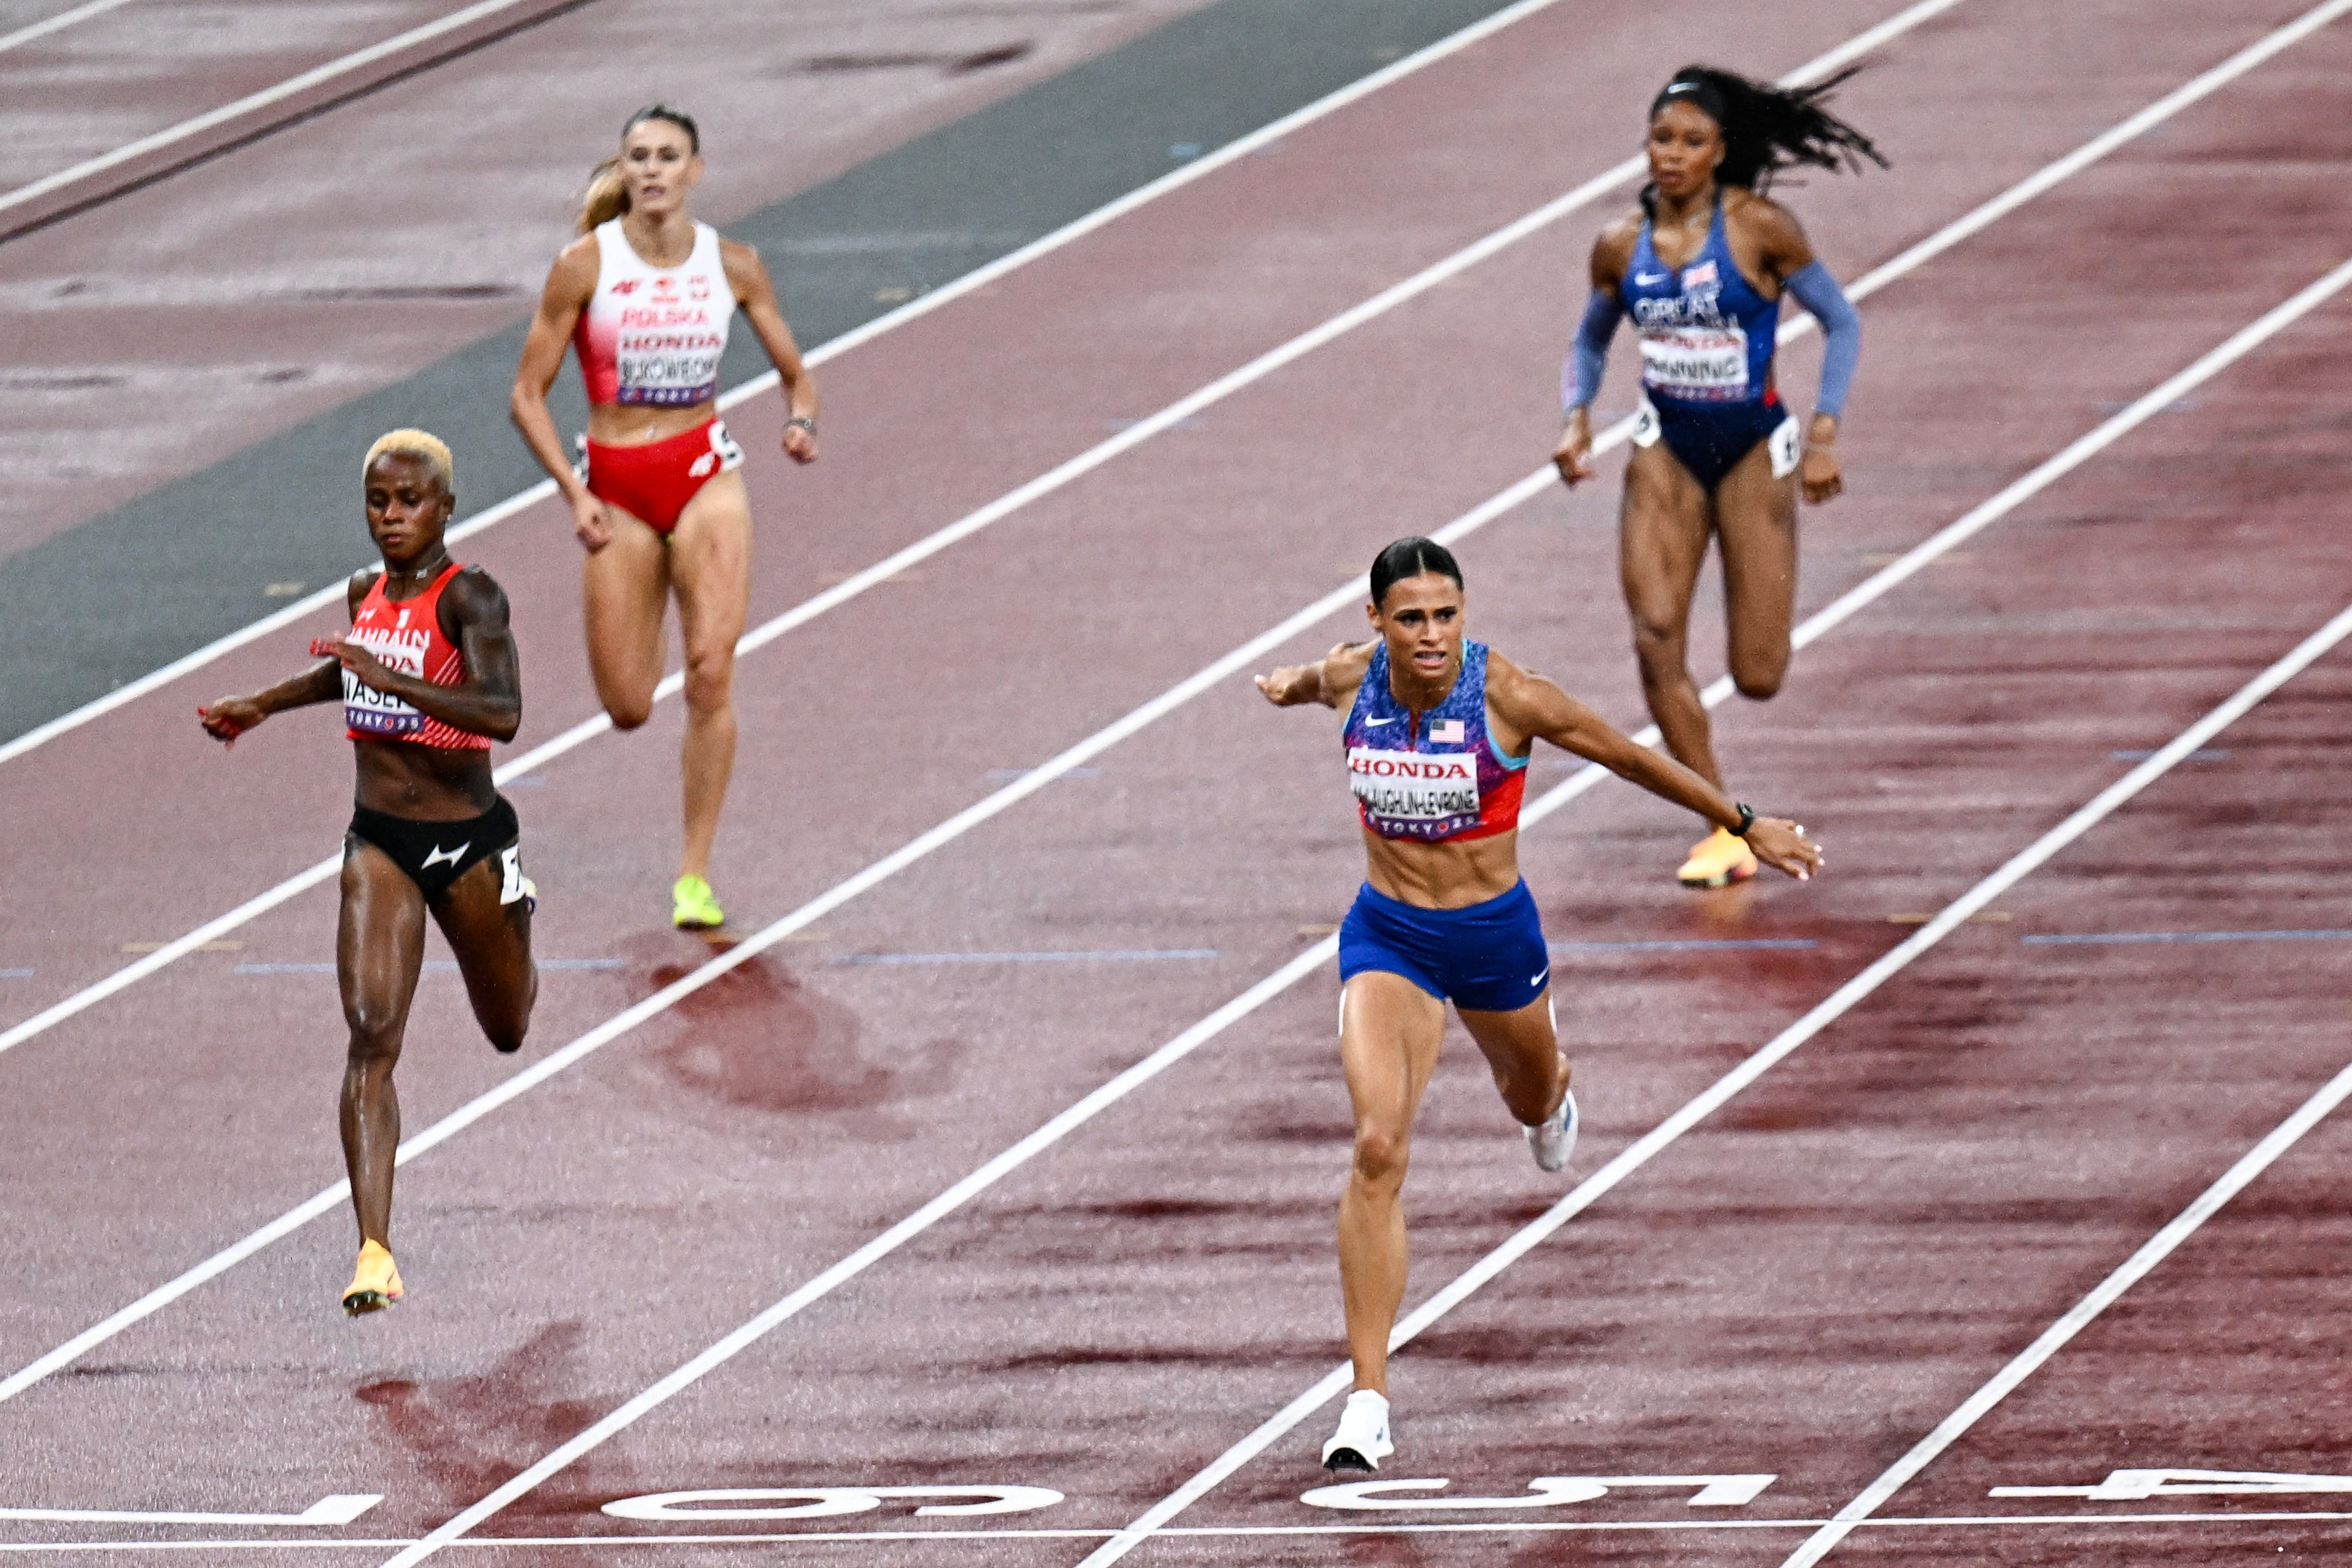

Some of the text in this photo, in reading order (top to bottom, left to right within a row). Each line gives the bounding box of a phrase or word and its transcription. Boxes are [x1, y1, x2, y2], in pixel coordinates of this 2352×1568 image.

[621, 333, 721, 350] HONDA
[349, 626, 430, 648] AHRAIN
[1352, 757, 1470, 779] HONDA
[601, 1485, 1065, 1520] 6
[1300, 1474, 1778, 1509] 5
